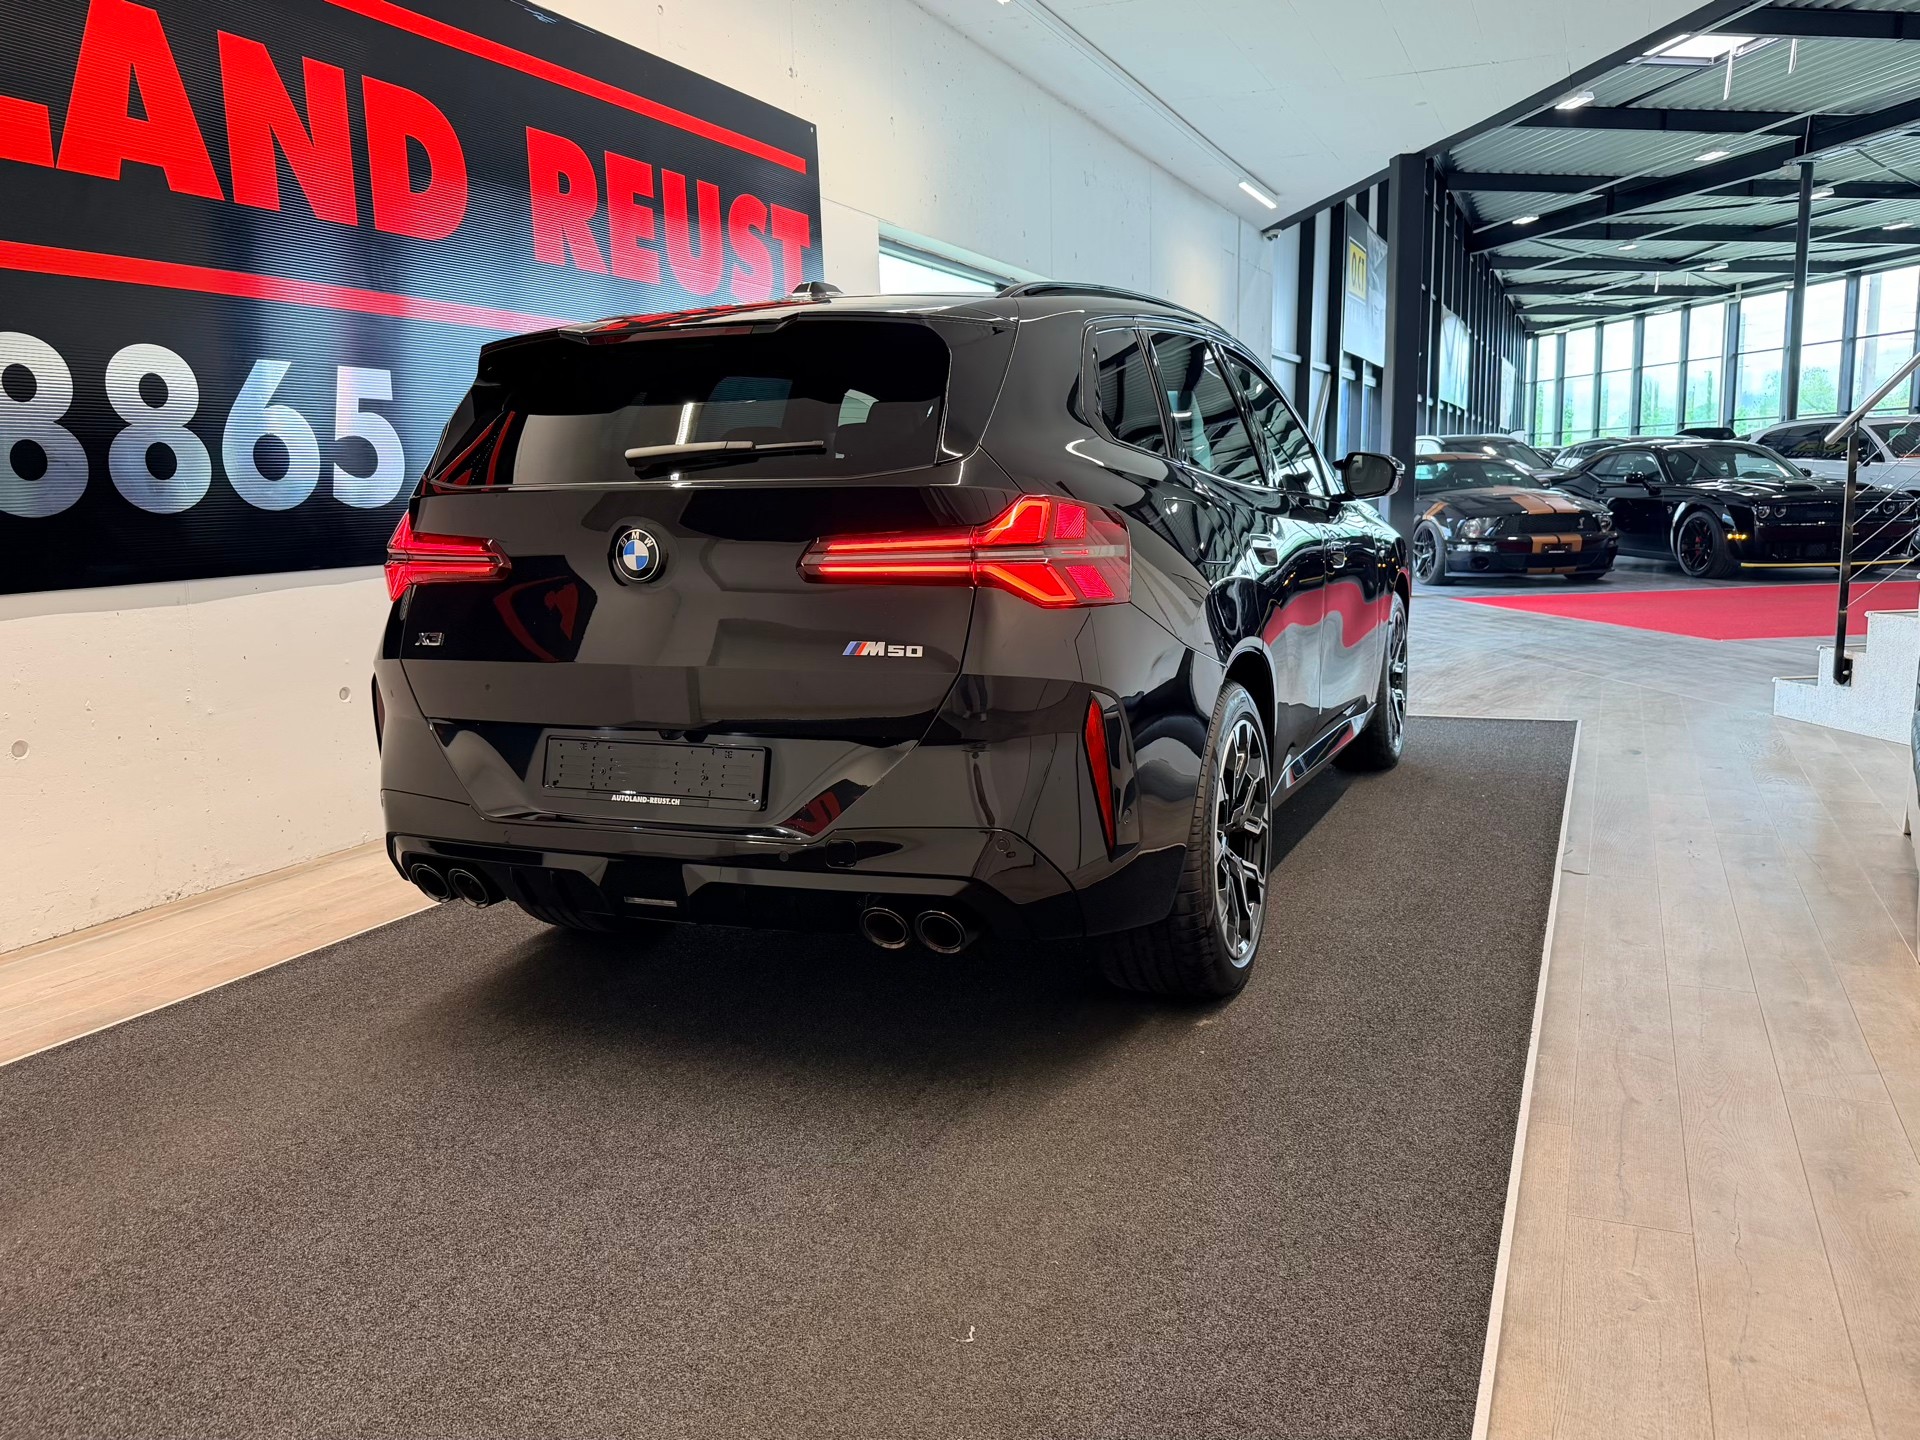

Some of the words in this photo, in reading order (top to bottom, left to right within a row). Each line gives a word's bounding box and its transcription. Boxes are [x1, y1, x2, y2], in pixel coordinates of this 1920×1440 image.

[526, 126, 811, 302] REUST
[0, 331, 405, 518] 8865
[620, 531, 654, 548] BMW
[415, 632, 443, 646] X3
[611, 794, 680, 806] AUTOLAND-REUST.CH
